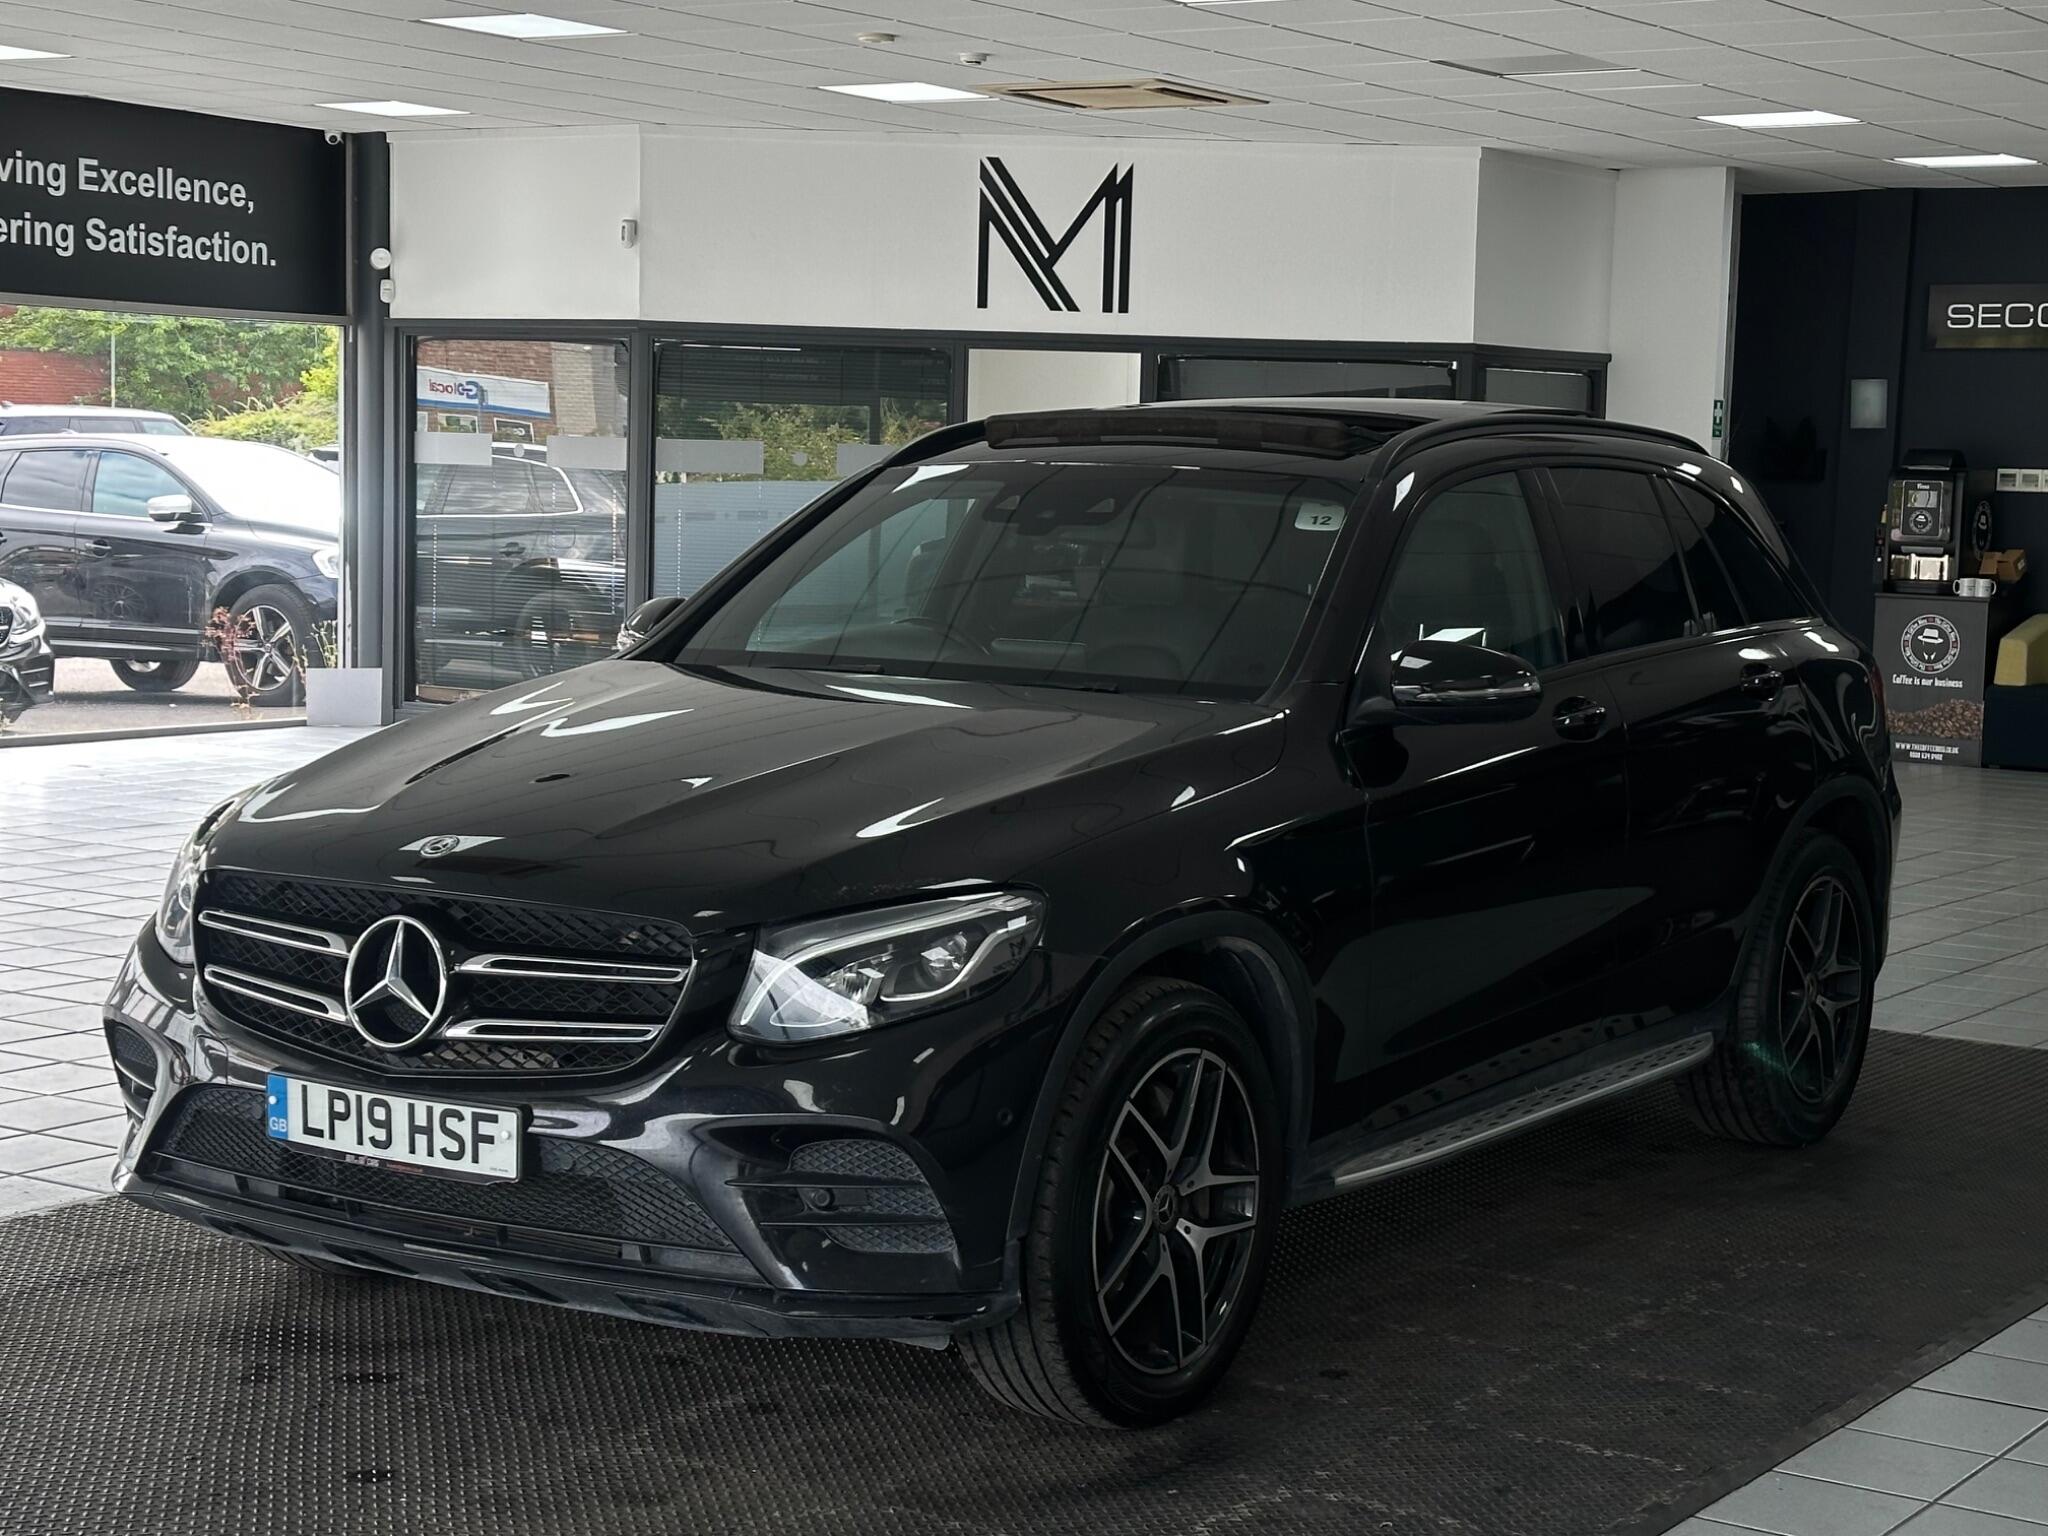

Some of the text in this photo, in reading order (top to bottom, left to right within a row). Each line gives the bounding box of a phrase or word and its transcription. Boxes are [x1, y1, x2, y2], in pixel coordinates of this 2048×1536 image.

[78, 157, 254, 214] Excellence,
[85, 217, 276, 267] Satisfaction.
[1310, 515, 1333, 526] 12
[1892, 673, 1913, 685] Coffee
[1914, 676, 1920, 686] is
[1934, 677, 1963, 689] business
[269, 1117, 288, 1133] GB
[301, 1084, 499, 1164] LP19 HSF
